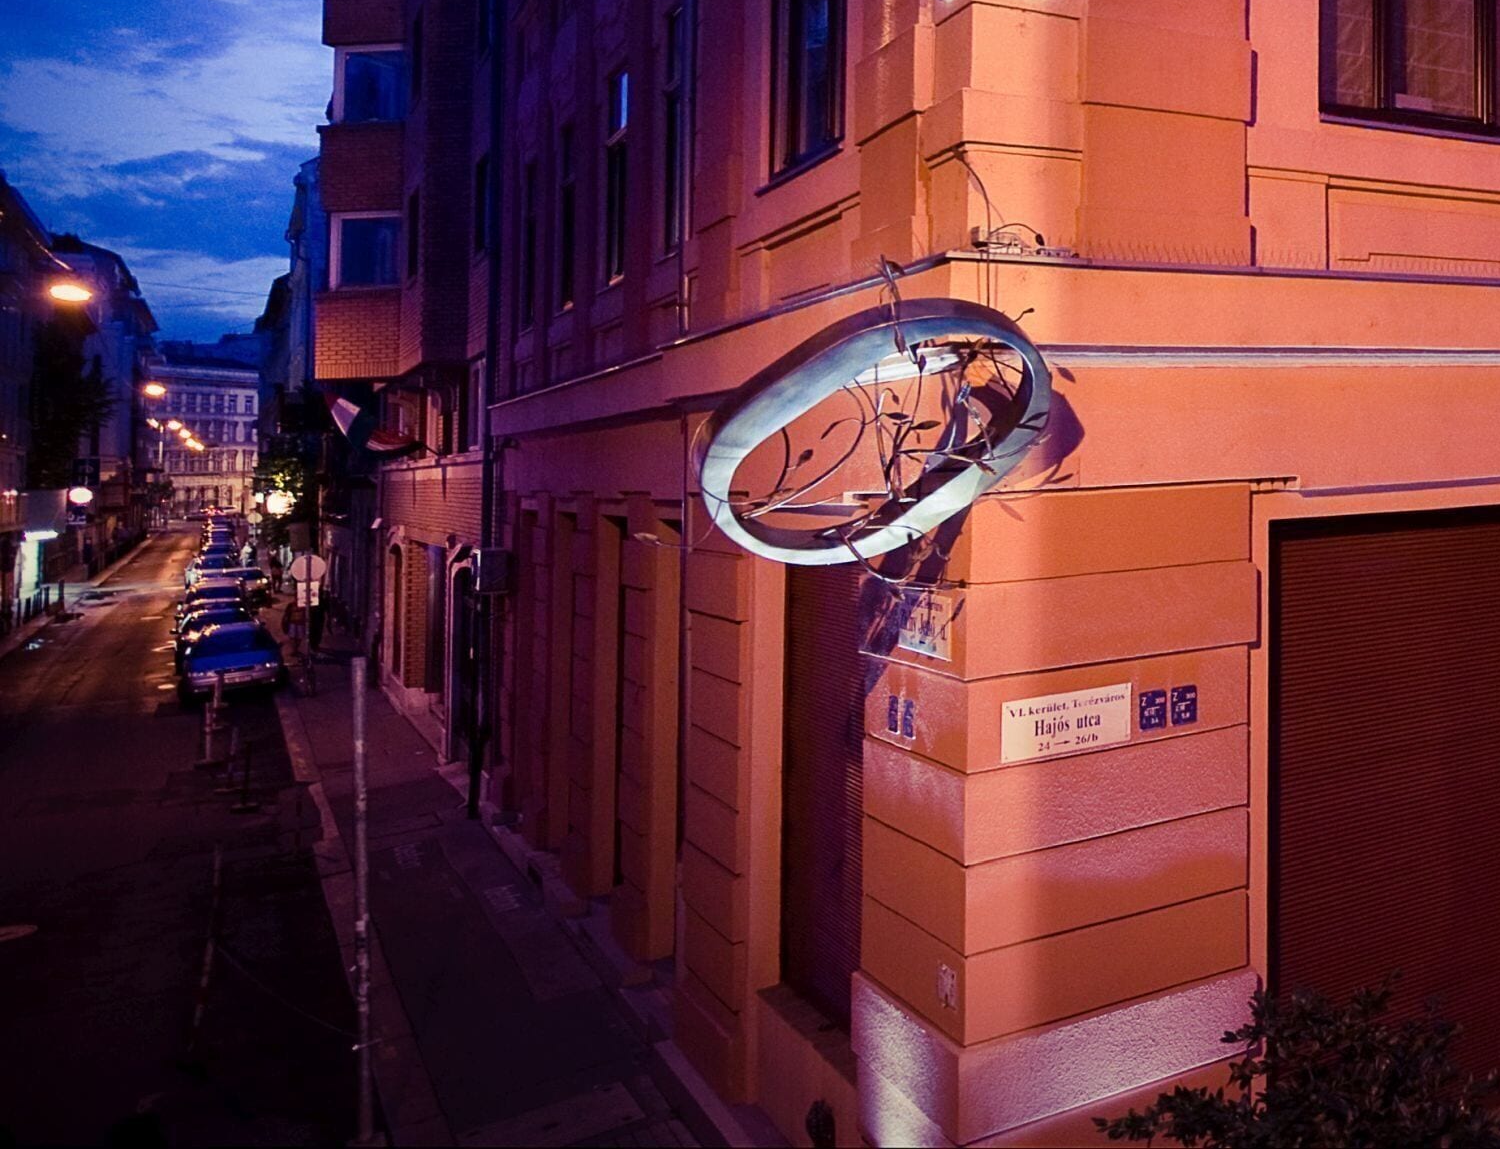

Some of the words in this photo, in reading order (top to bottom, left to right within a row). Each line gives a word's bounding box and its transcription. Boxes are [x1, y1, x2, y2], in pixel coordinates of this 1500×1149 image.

[1034, 715, 1070, 738] Hajós
[1076, 714, 1101, 729] utca
[1038, 742, 1051, 752] 24
[1075, 733, 1099, 745] 26/b
